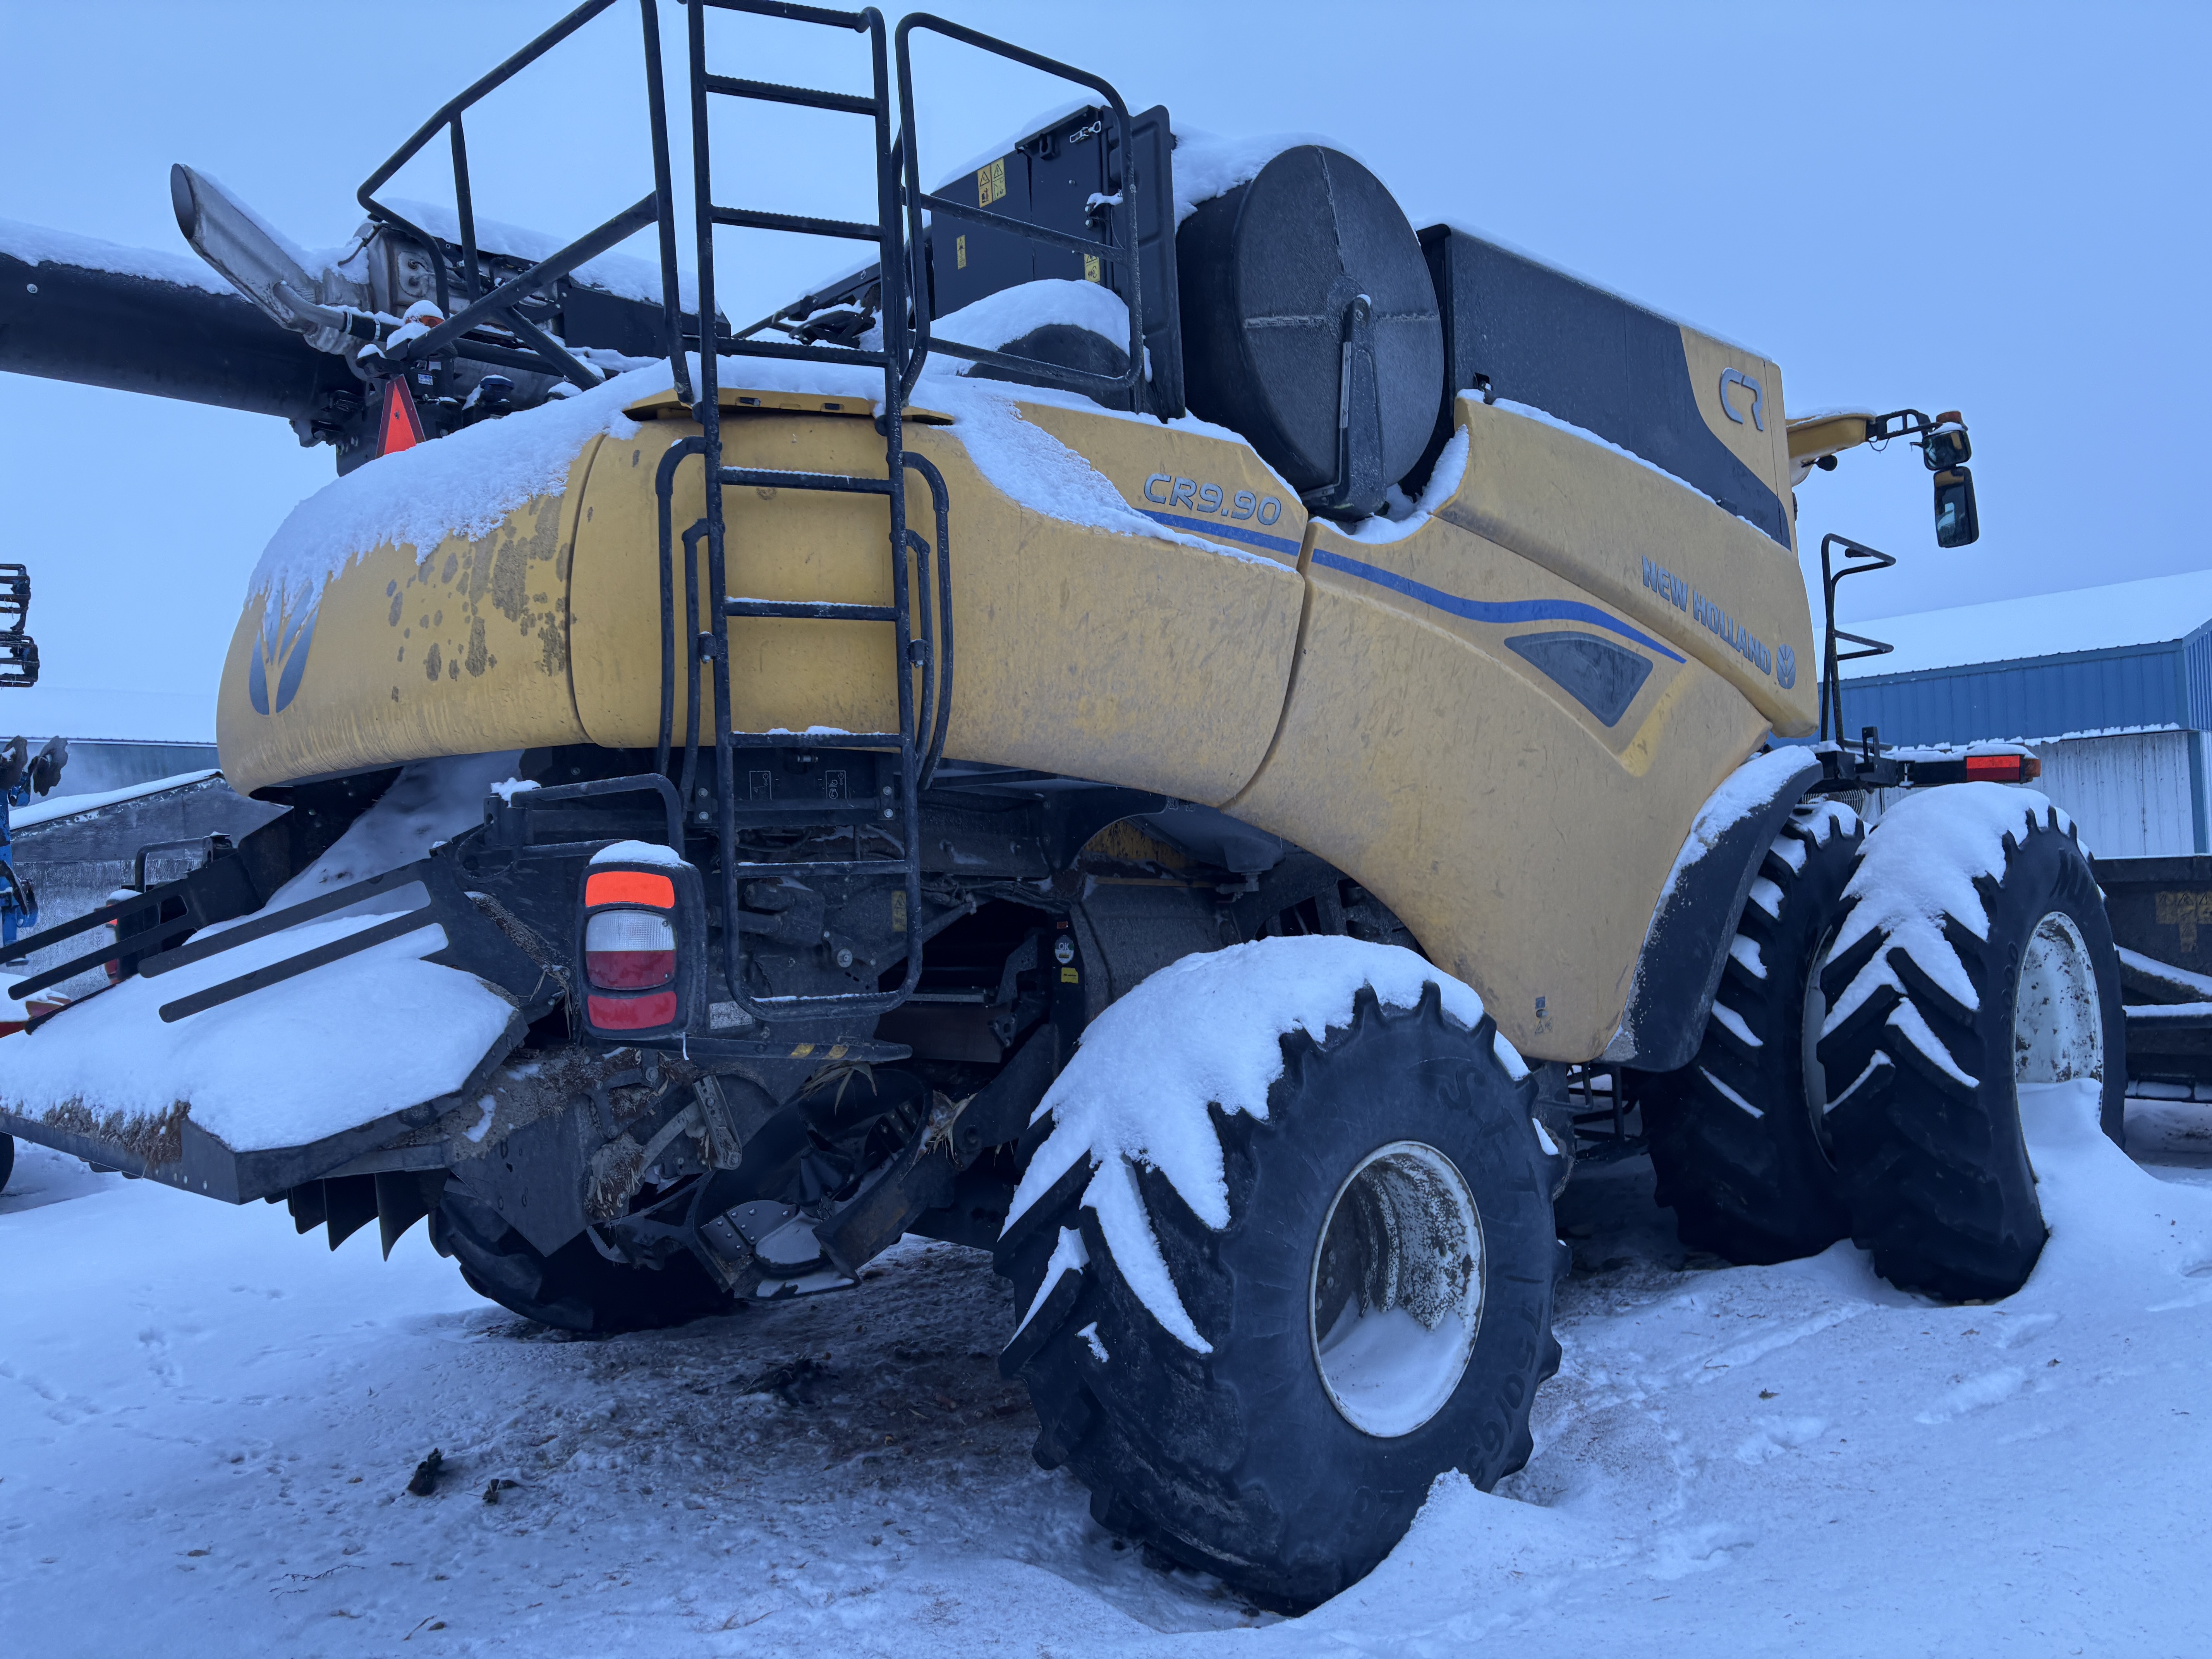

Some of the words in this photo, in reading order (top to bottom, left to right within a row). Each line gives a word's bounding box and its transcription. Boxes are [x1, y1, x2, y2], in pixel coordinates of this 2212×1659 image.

[1144, 473, 1281, 526] CR9.90
[1642, 555, 1688, 613] NEW
[1693, 589, 1772, 675] HOLLAND
[1058, 942, 1069, 951] OK
